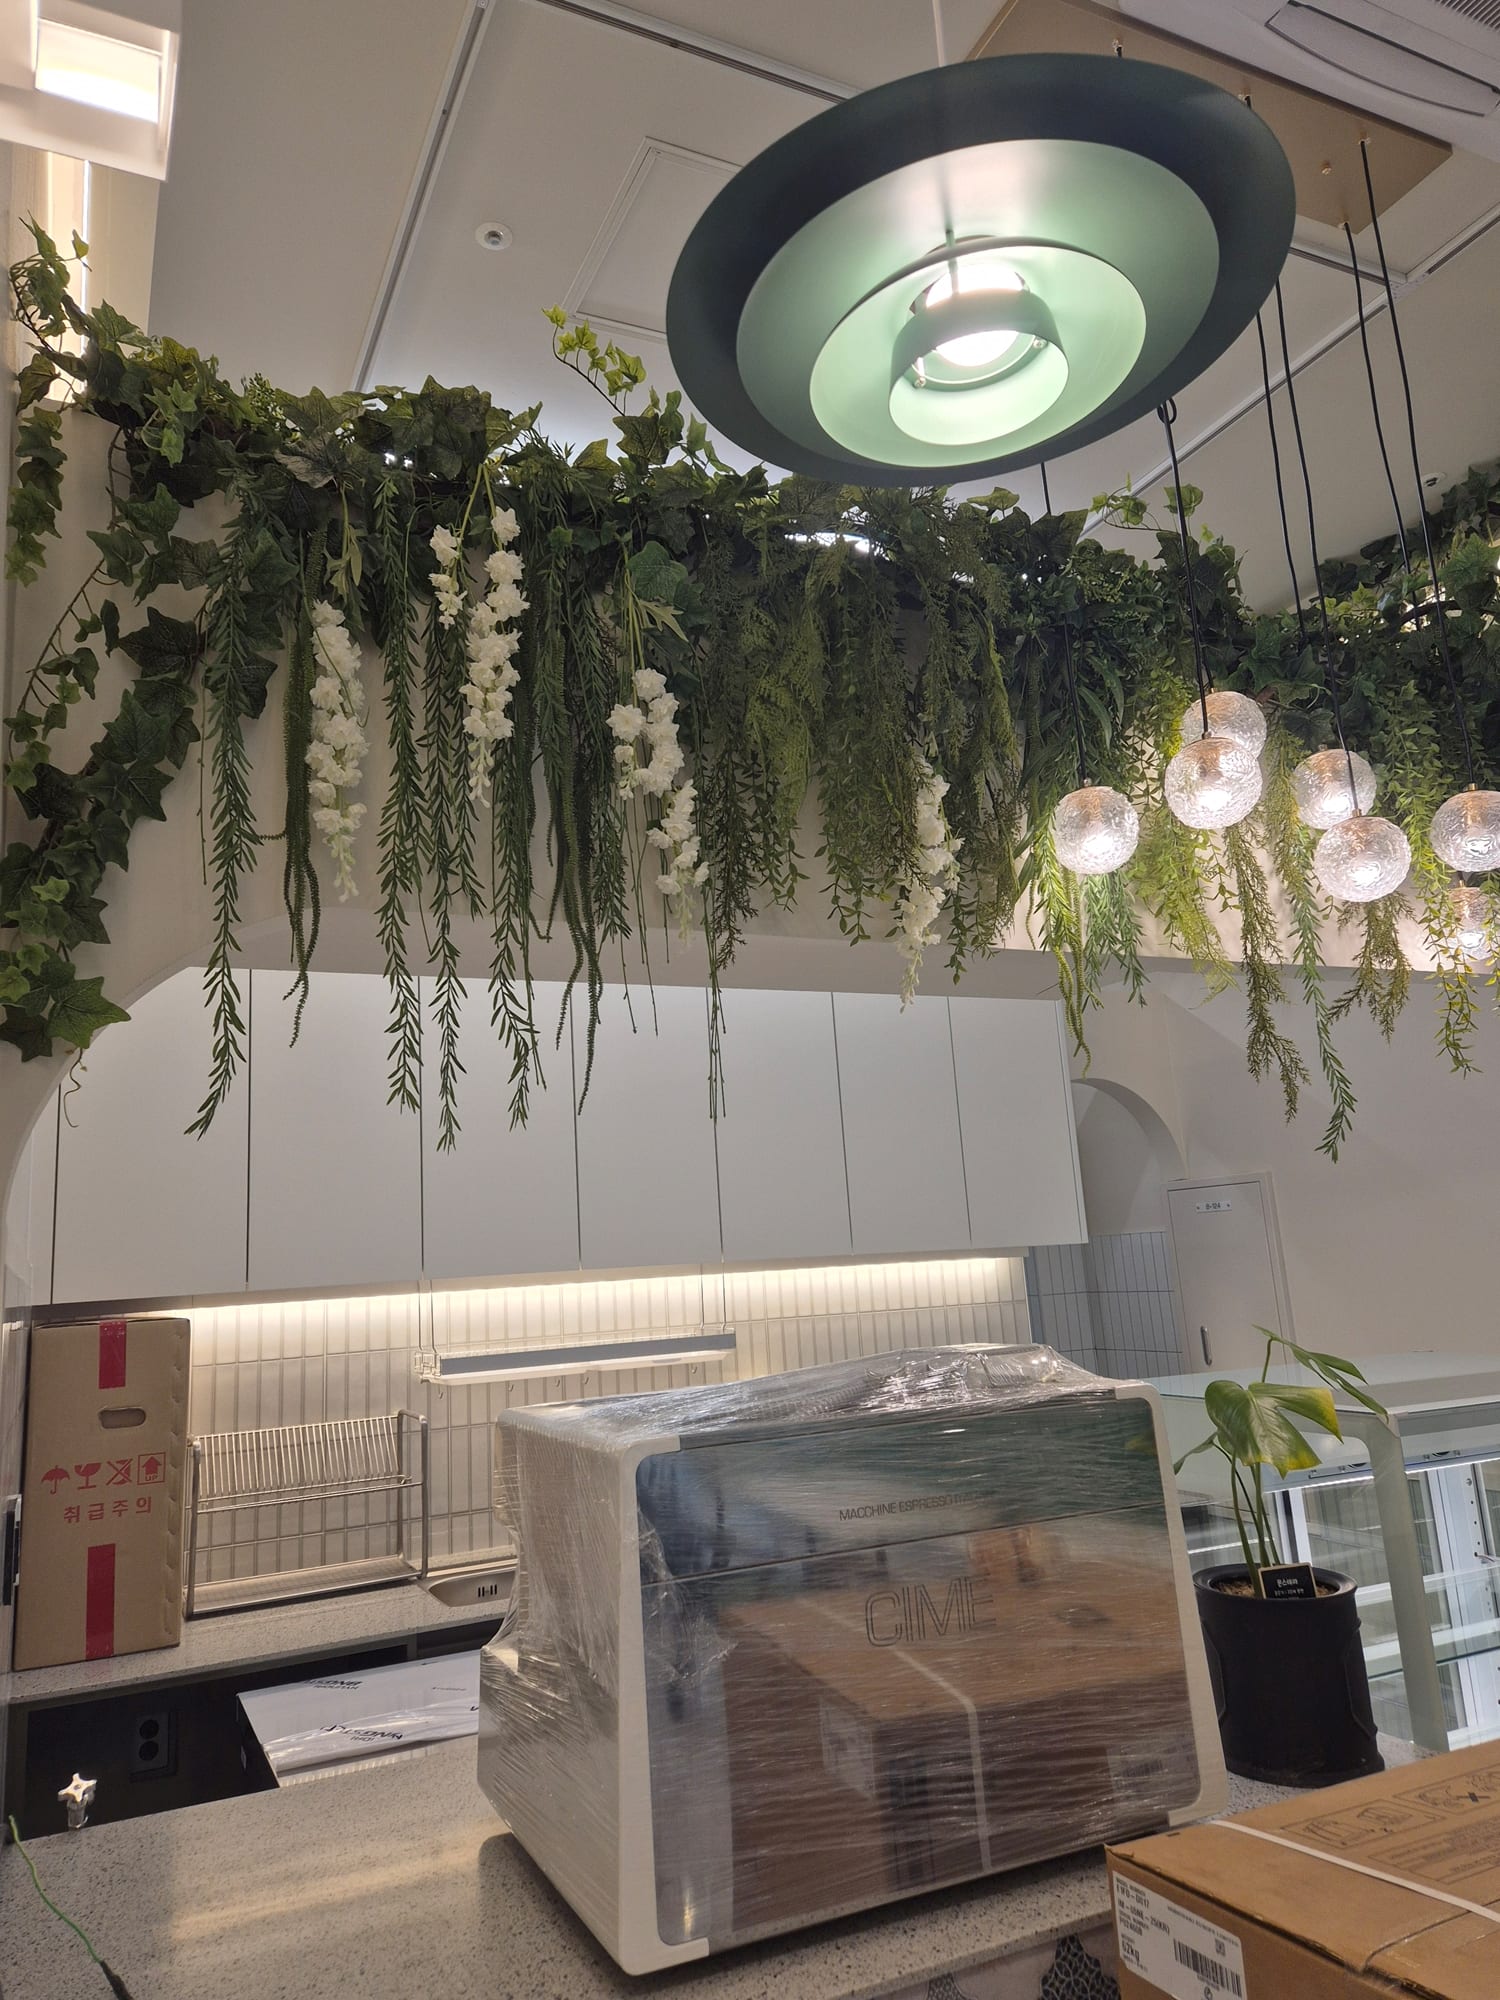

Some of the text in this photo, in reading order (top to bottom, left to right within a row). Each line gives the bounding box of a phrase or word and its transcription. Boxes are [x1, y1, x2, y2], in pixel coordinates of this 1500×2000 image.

[145, 1474, 158, 1482] UP
[839, 1502, 897, 1521] MACCHINE
[865, 1573, 997, 1647] CIME
